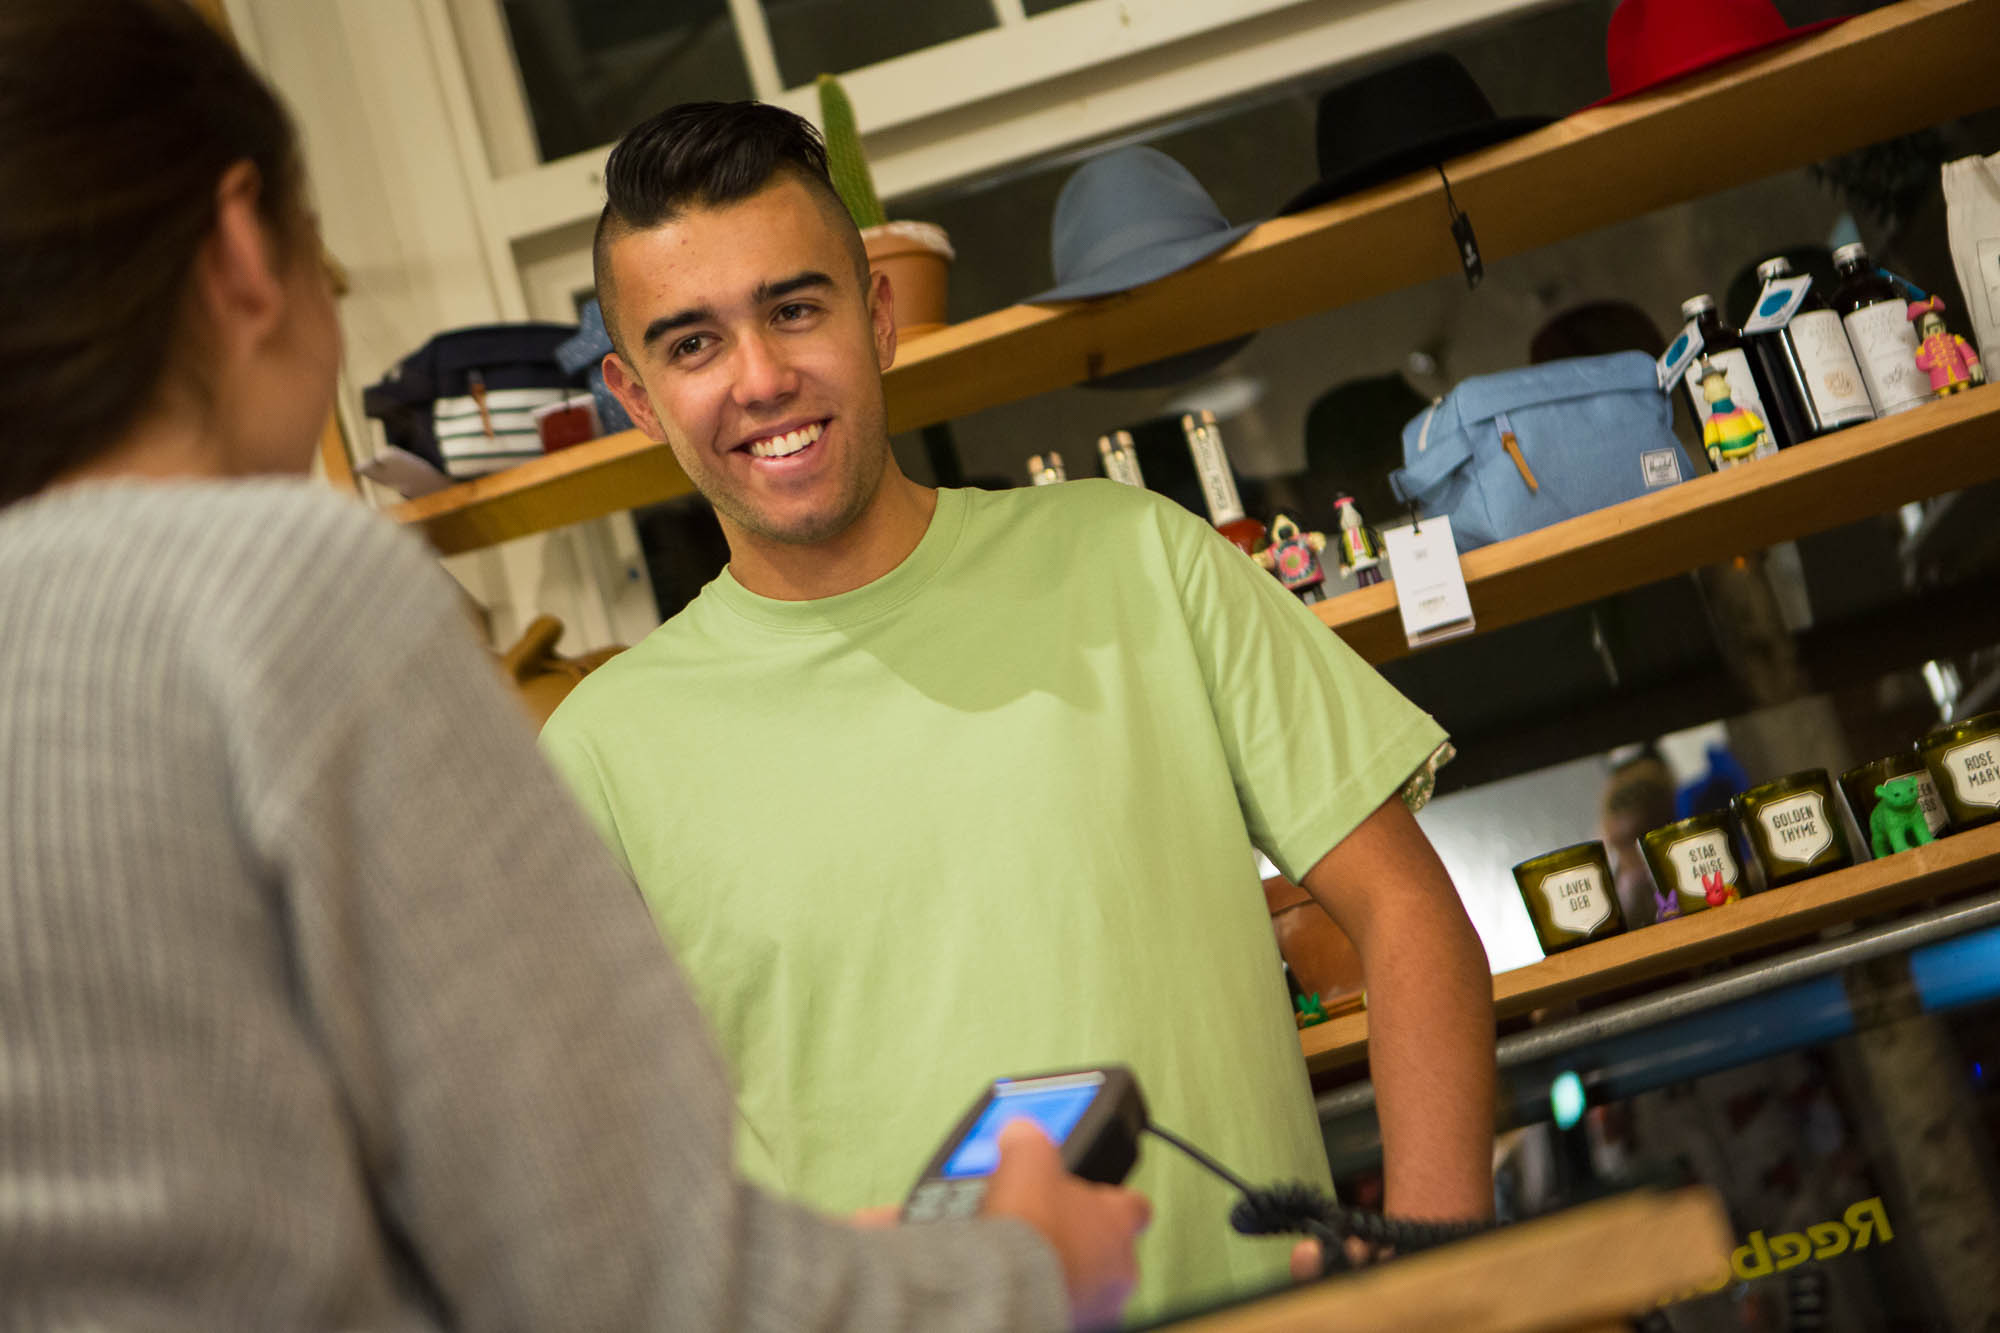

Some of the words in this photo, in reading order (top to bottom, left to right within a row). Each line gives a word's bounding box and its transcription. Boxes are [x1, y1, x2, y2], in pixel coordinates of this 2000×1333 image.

[1964, 750, 1995, 771] ROSE
[1772, 804, 1815, 829] GOLDEN
[1780, 820, 1818, 843] THYME
[1689, 844, 1717, 862] STAR
[1692, 857, 1725, 880] ANISE
[1559, 877, 1593, 898] LAVEN
[1569, 894, 1591, 912] DER
